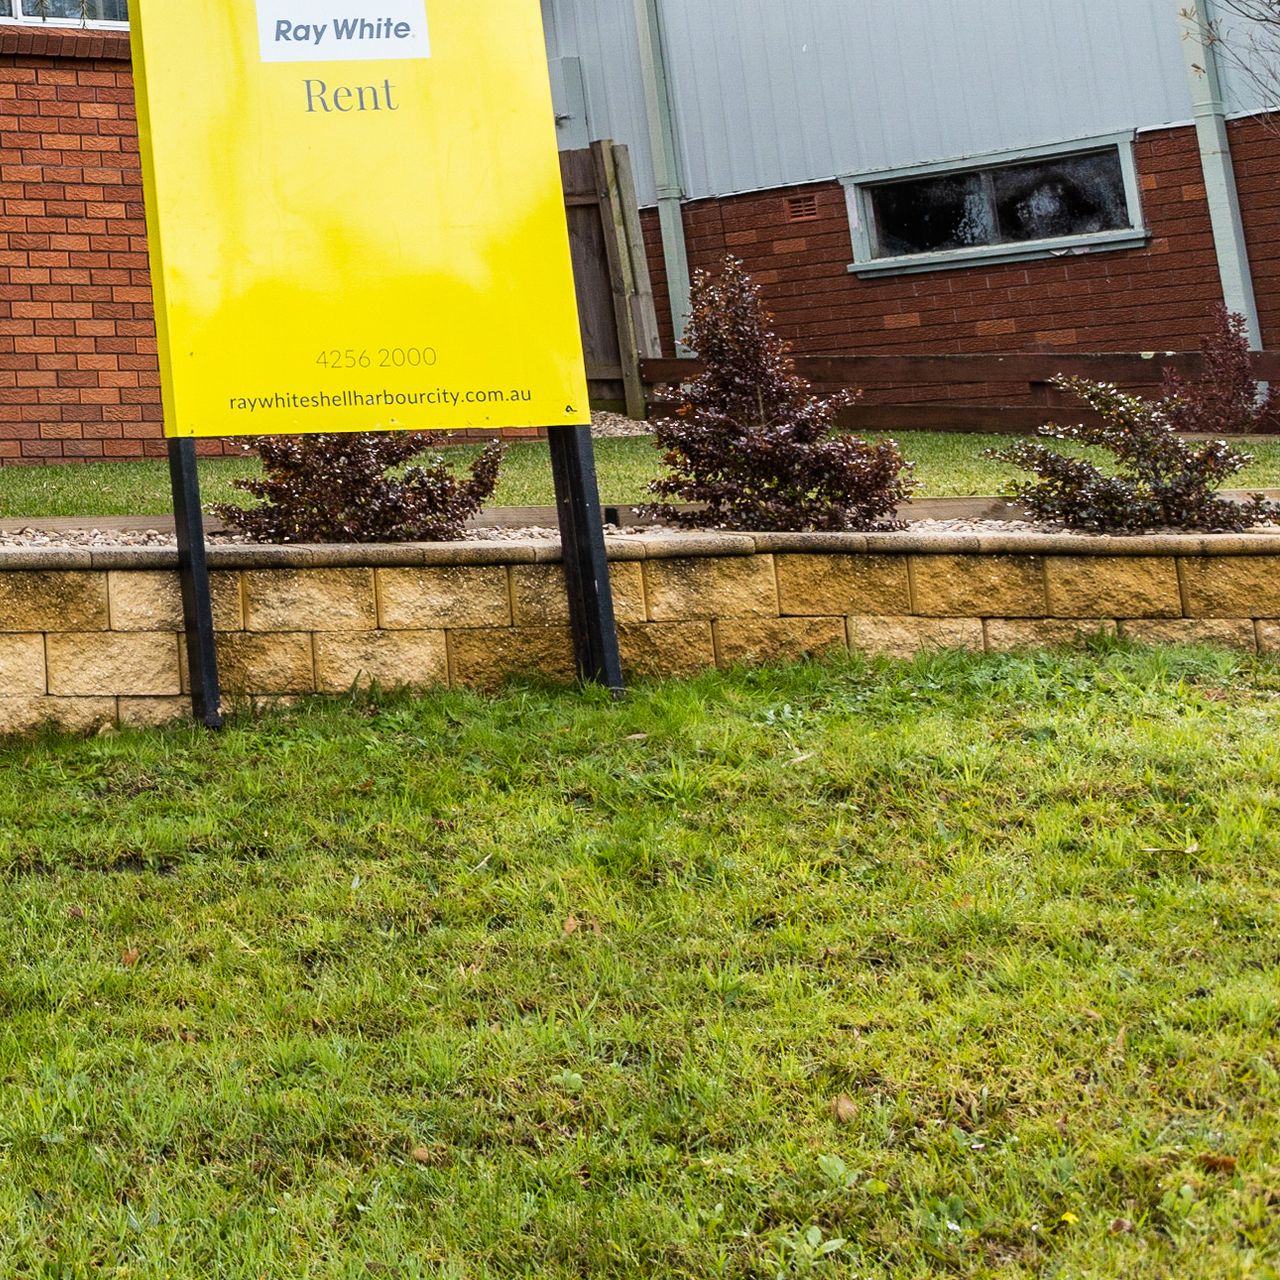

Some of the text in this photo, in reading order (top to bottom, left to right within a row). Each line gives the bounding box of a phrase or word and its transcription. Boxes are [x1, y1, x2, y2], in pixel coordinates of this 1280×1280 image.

[274, 17, 412, 45] Ray White
[302, 79, 400, 113] Rent
[315, 347, 437, 369] 4256 2000
[229, 387, 532, 412] raywhiteshellharbourcity.com.au
